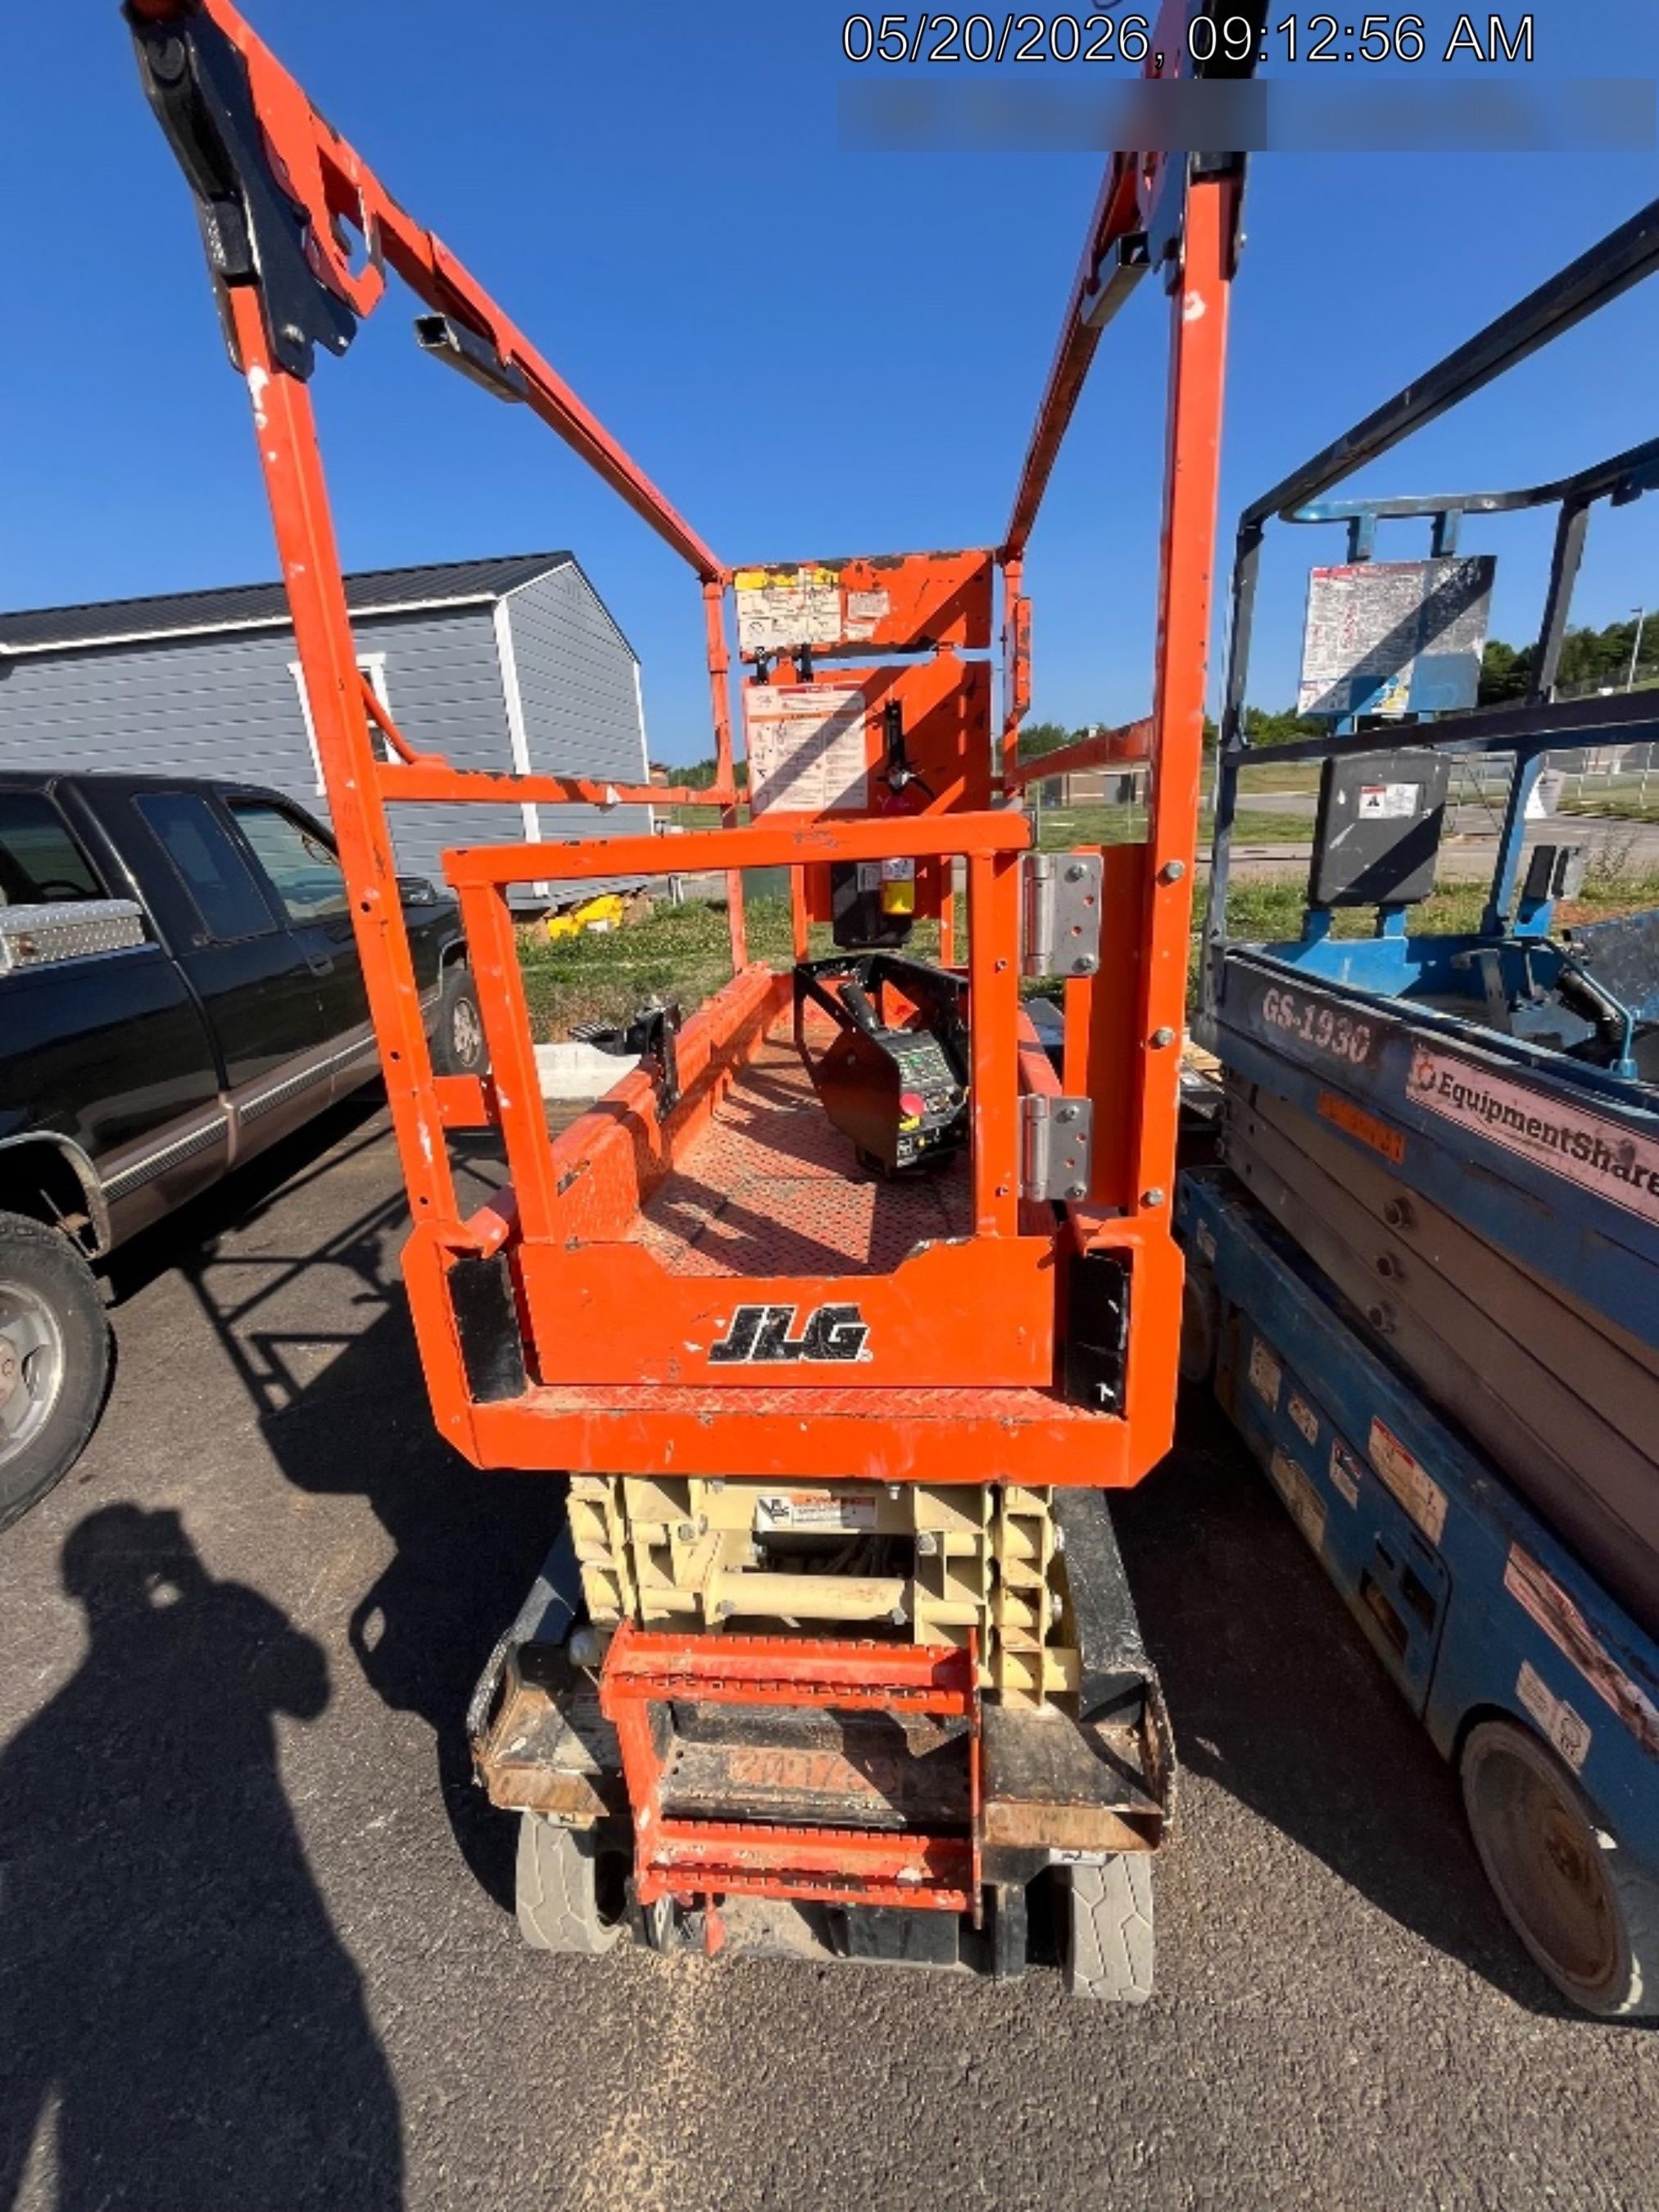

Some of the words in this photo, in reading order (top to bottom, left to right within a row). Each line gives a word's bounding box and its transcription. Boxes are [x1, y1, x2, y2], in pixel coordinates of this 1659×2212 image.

[1262, 988, 1370, 1063] GS-1930
[1437, 1071, 1659, 1196] EquipmentShare
[707, 1302, 871, 1366] JLG
